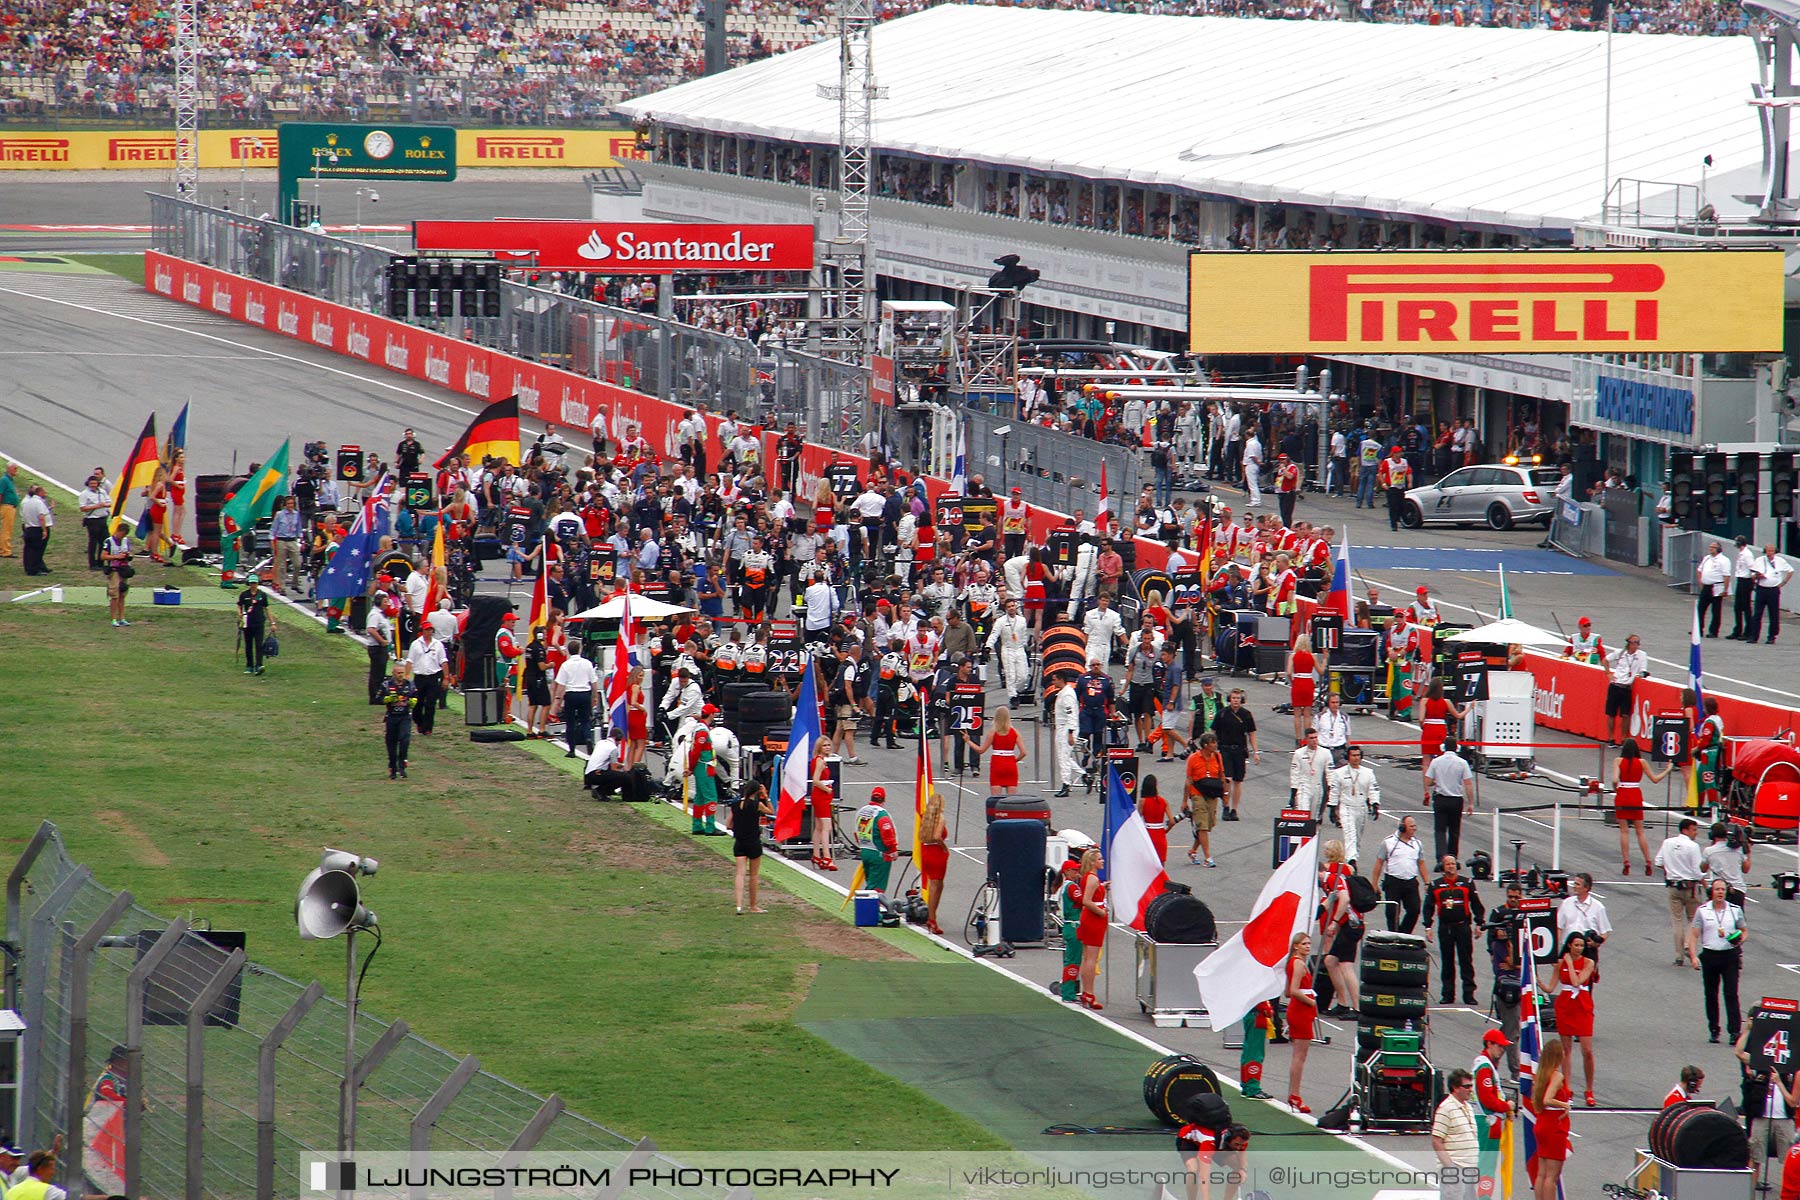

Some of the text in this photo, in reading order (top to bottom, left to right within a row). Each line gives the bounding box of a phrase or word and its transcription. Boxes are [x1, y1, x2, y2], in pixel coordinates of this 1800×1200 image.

[405, 150, 445, 159] ROLEX
[477, 137, 564, 158] PIRELLI
[616, 231, 774, 262] Santander
[1309, 264, 1665, 341] PIRELLI
[1597, 376, 1693, 434] HOCKENHEIMRING
[343, 461, 357, 478] 6
[833, 475, 857, 492] 77
[938, 507, 963, 527] 20
[590, 560, 614, 580] 14
[1175, 584, 1201, 604] 26
[768, 650, 800, 673] 22
[1463, 673, 1481, 697] 7
[951, 706, 983, 730] 25
[1662, 731, 1680, 756] 8
[1518, 927, 1553, 958] 10
[1763, 1030, 1791, 1065] 4
